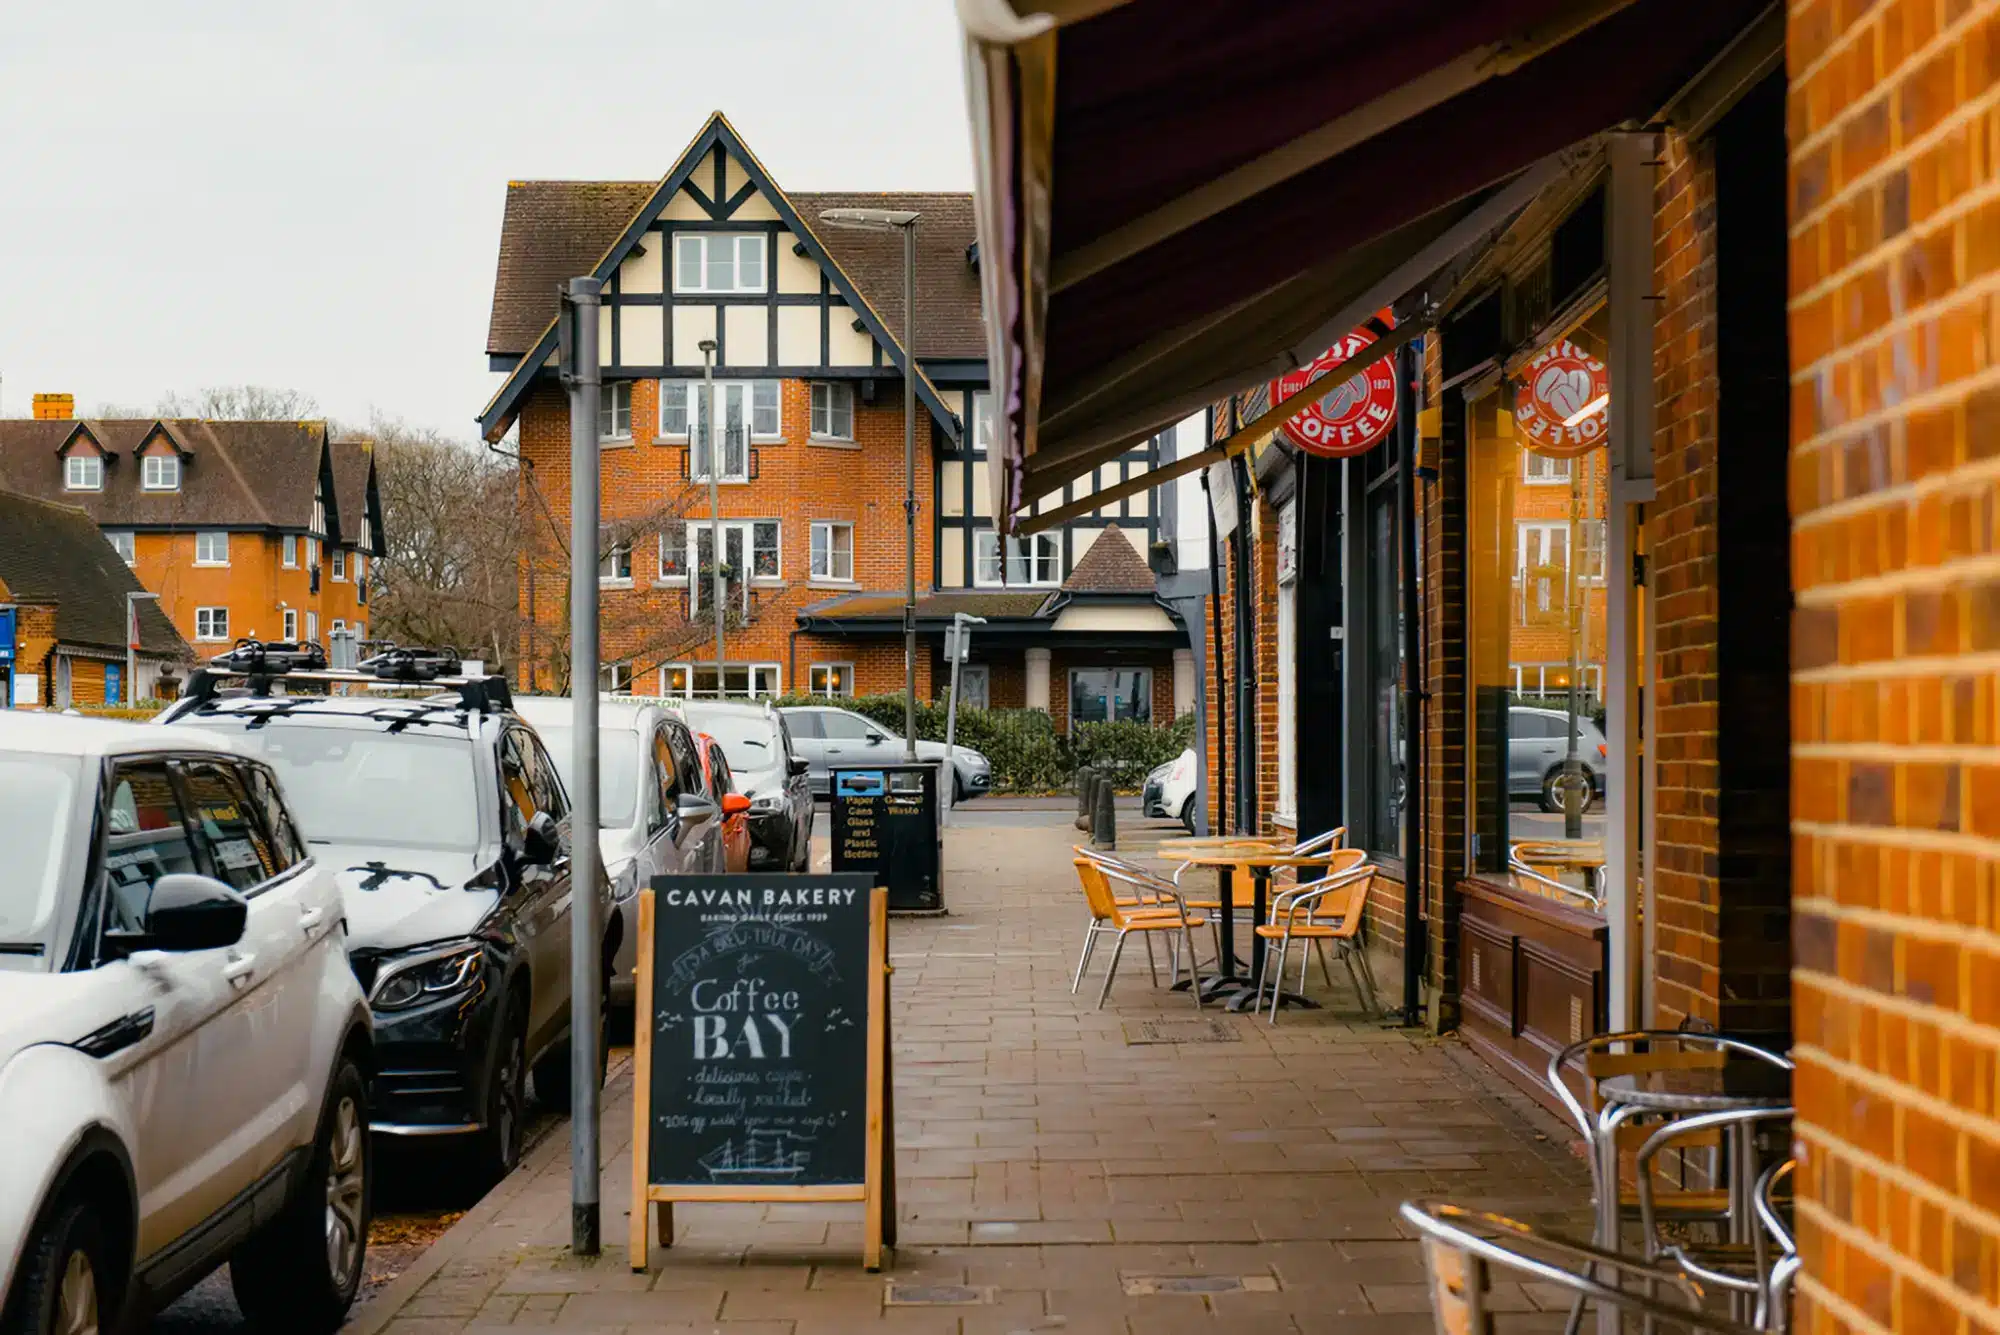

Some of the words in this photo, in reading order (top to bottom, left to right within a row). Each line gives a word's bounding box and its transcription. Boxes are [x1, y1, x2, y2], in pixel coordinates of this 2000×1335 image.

[844, 839, 877, 848] Plastic
[667, 888, 752, 906] CAVAN
[764, 888, 856, 906] BAKERY
[700, 913, 737, 922] BAKING
[773, 913, 803, 922] SINCE
[807, 913, 828, 922] 1929
[691, 978, 800, 1013] Coffee
[692, 1014, 804, 1060] BAY
